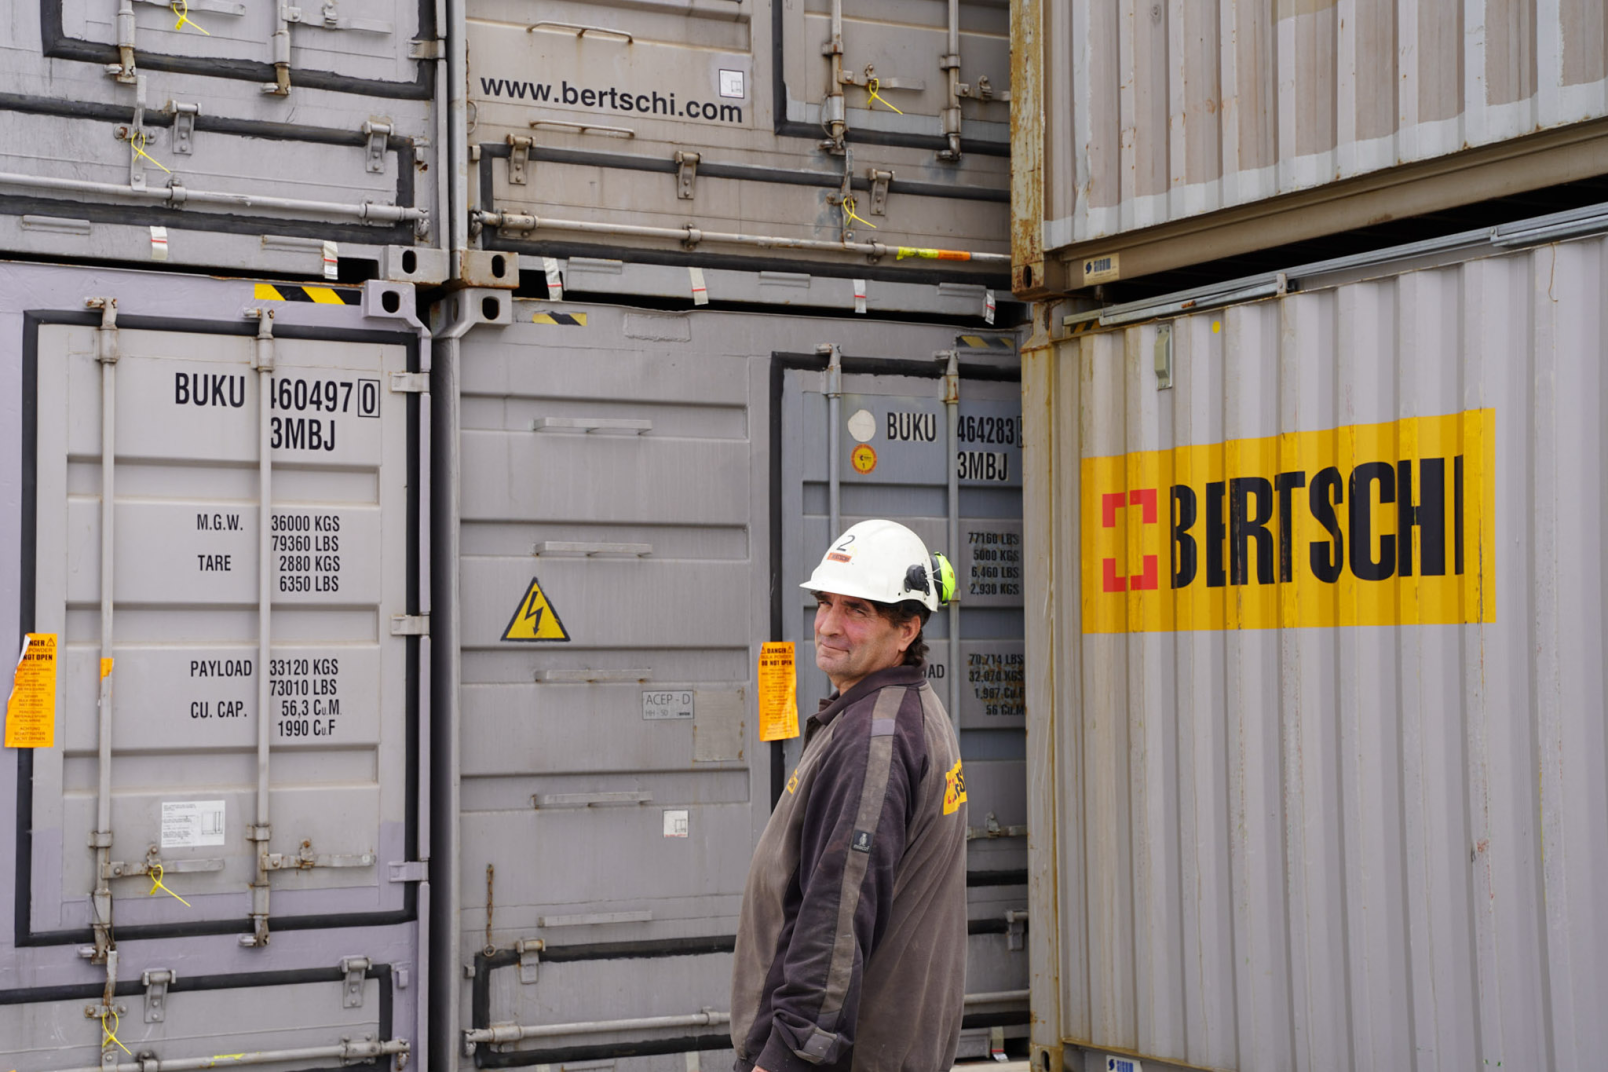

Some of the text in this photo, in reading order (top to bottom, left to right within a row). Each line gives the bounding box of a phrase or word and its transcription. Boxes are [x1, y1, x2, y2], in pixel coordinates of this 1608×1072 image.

[480, 77, 743, 123] www.bertschi.com
[175, 372, 245, 408] BUKU
[361, 381, 377, 415] 0
[270, 416, 335, 451] 3MBJ
[887, 411, 936, 442] BUKU
[957, 415, 1015, 445] 464283
[957, 451, 1008, 481] 3MBJ
[197, 513, 340, 532] M.G.W. 36000 KGS
[1170, 454, 1464, 590] BERTSCHI
[271, 535, 339, 552] 79360 LBS
[836, 534, 856, 552] 2
[968, 532, 1020, 545] 77160 LBS
[197, 554, 340, 572] TARE 2880 KGS
[1000, 549, 1020, 562] KGS
[971, 566, 1020, 579] 6,460 LBS
[279, 575, 339, 592] 6350 LBS
[970, 583, 1020, 596] 2,930 KGS
[190, 658, 339, 677] PAYLOAD 33120 KGS
[269, 679, 337, 696] 73010 LBS
[646, 693, 673, 706] ACEP
[682, 693, 691, 705] D
[190, 701, 213, 719] CU.
[217, 700, 247, 718] CAP.
[281, 699, 309, 718] 56,3
[986, 704, 999, 716] 56
[277, 720, 309, 737] 1990
